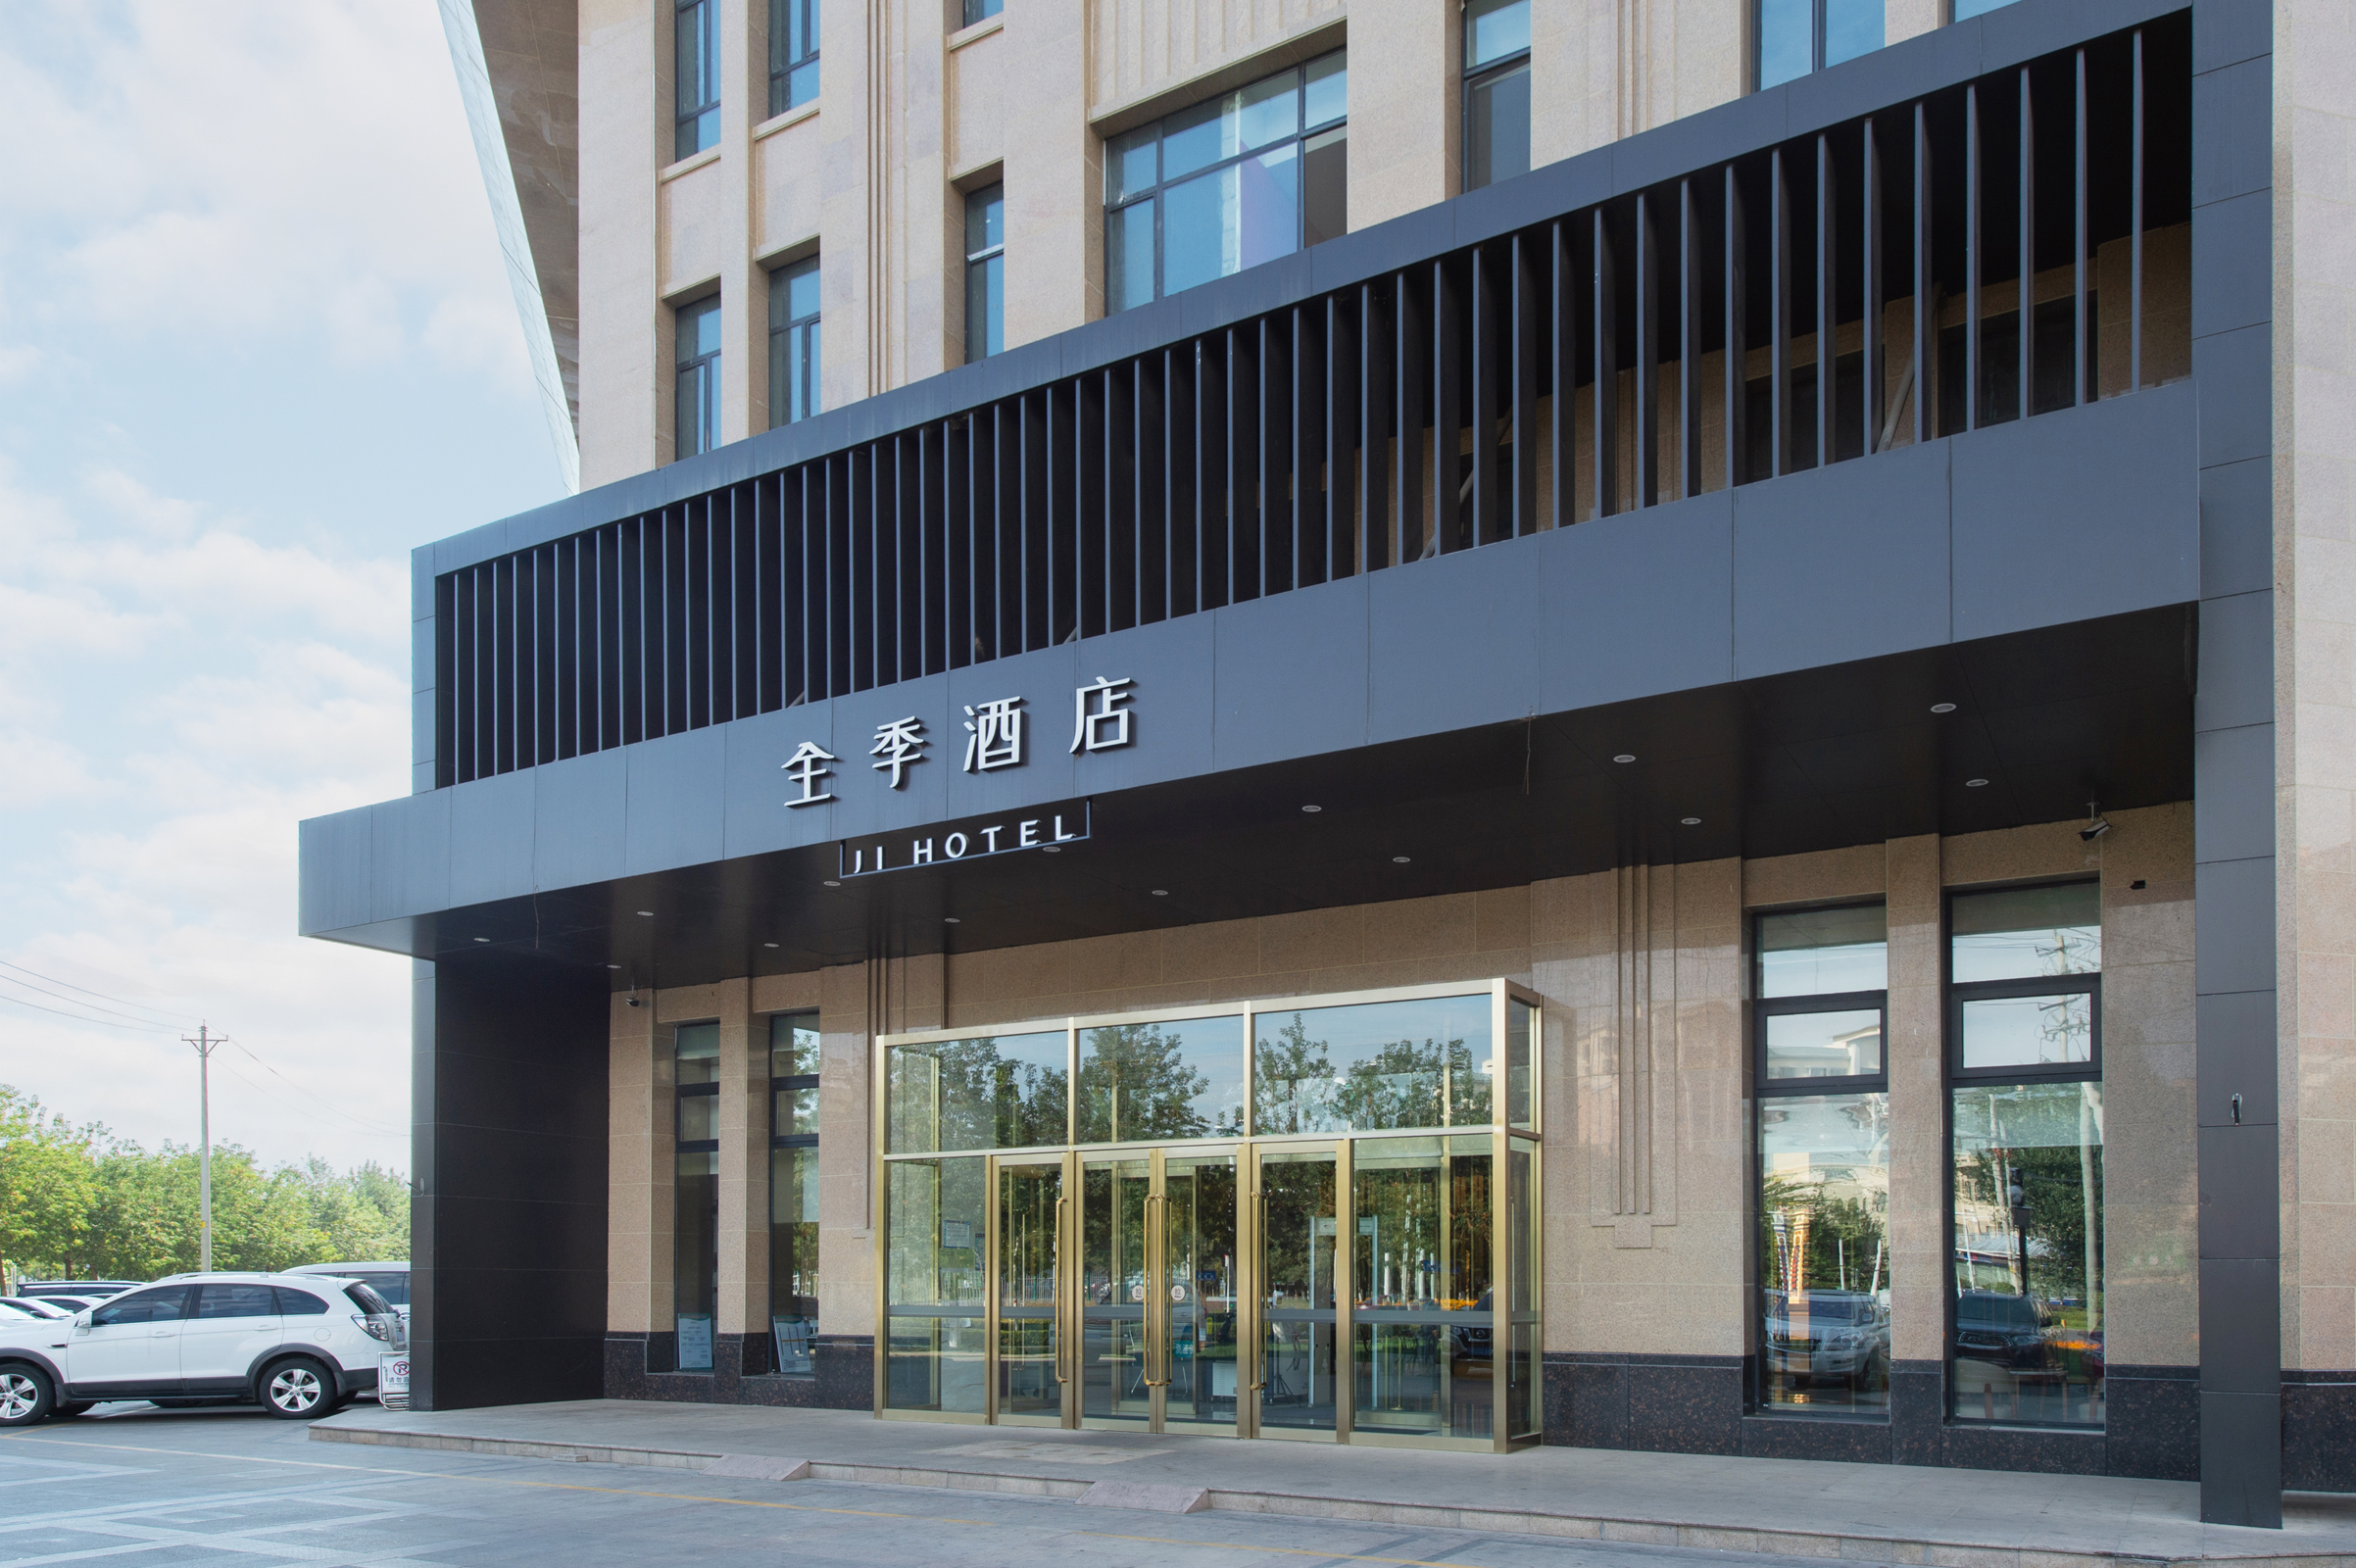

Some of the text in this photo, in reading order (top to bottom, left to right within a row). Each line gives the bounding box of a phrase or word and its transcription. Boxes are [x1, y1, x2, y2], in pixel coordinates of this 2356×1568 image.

[781, 675, 1132, 807] 全季酒店
[853, 815, 1077, 874] JI HOTEL
